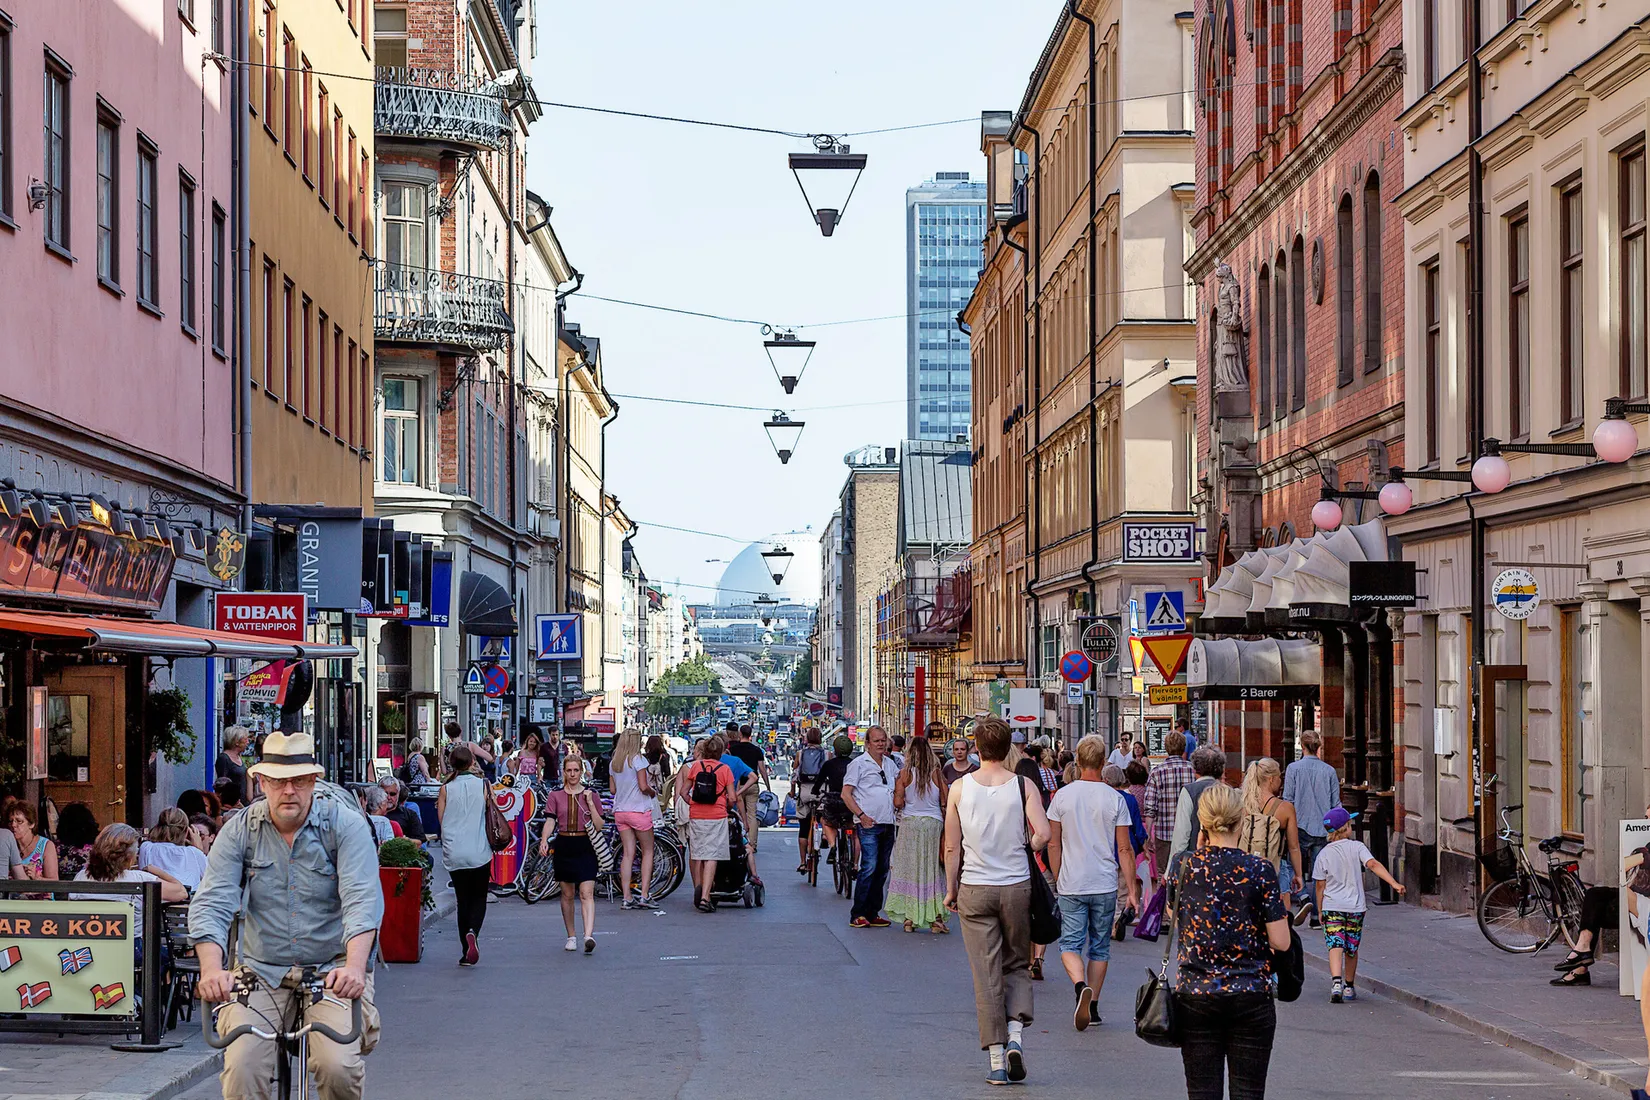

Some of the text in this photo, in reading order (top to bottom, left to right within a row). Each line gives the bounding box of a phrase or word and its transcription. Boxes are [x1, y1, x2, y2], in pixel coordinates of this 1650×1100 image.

[1129, 528, 1188, 539] POCKET
[1128, 539, 1189, 556] SHOP
[67, 537, 107, 586] BAR
[106, 545, 123, 588] &
[302, 521, 319, 603] GRANIT
[1616, 560, 1624, 576] 38
[1493, 571, 1521, 598] FOUNTAIN
[223, 605, 297, 620] TOBAK
[233, 623, 297, 632] VATTENPIPOR
[1085, 638, 1116, 647] TULLY'S
[242, 688, 277, 698] COMVIQ
[1151, 686, 1186, 696] Flervägs-
[1240, 688, 1278, 698] 2 Barer
[1156, 693, 1184, 704] väjning
[40, 919, 59, 936] &
[67, 914, 124, 937] KÖK
